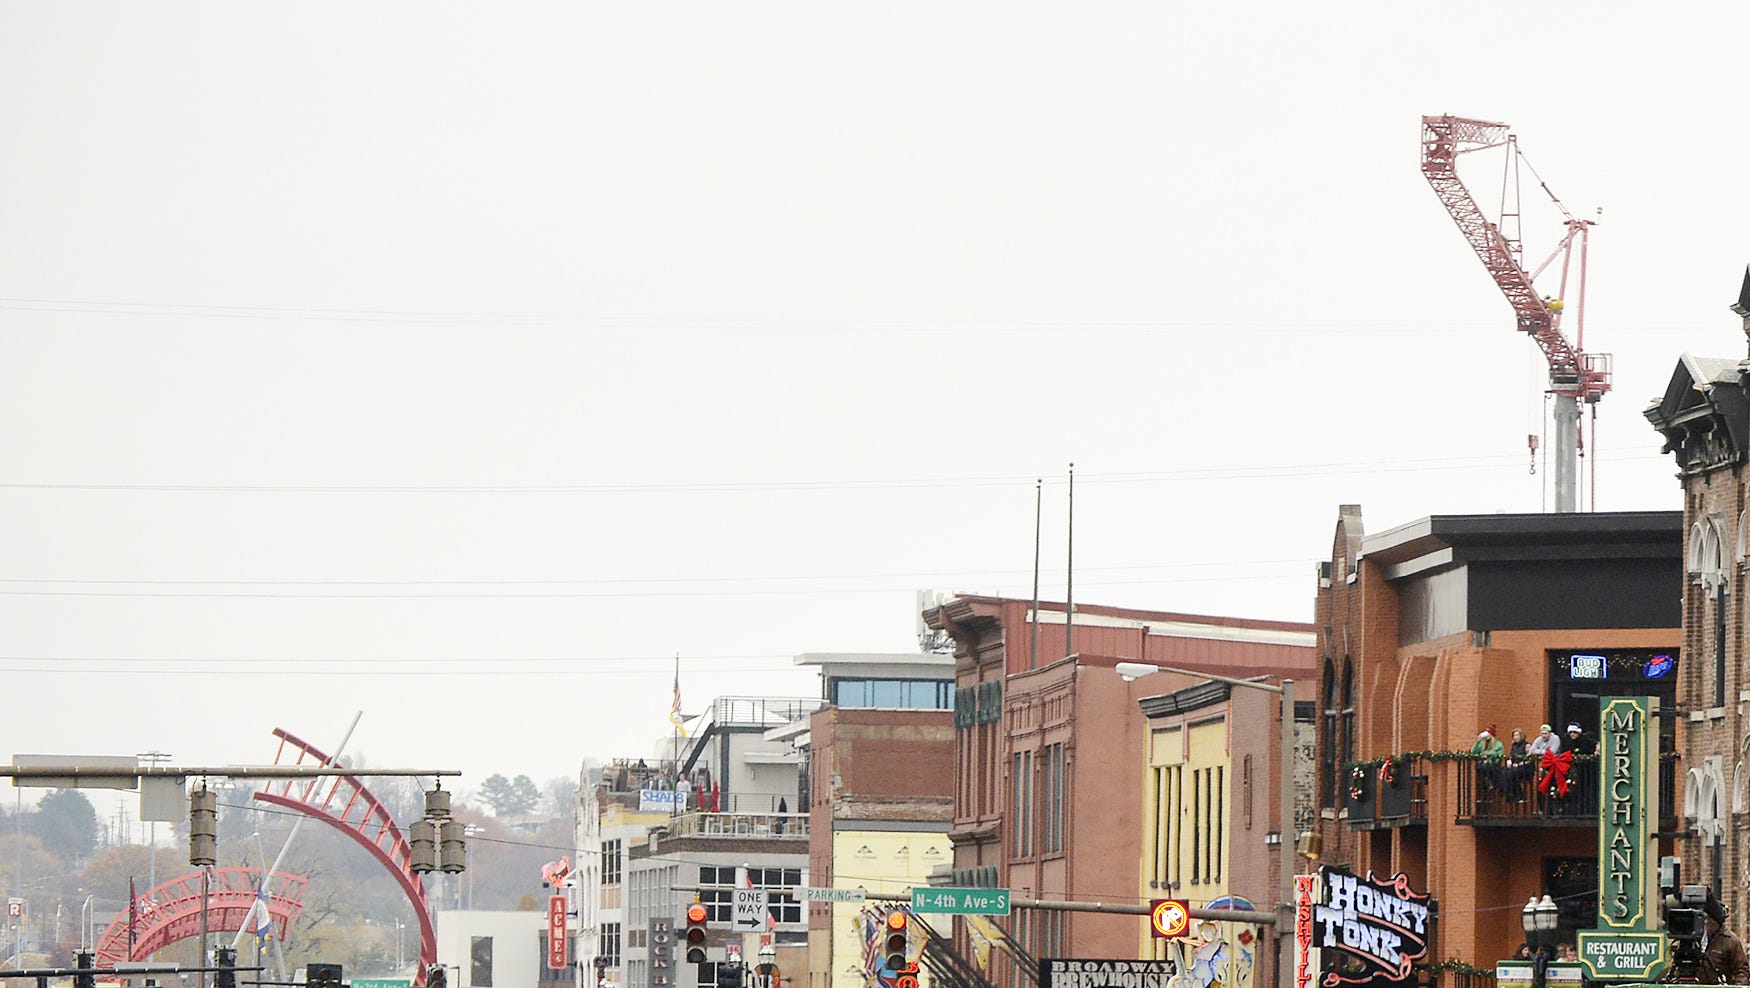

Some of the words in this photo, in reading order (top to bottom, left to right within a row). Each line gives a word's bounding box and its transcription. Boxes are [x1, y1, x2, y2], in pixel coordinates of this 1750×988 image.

[1577, 658, 1601, 668] BUD
[1609, 709, 1635, 919] MERCHANTS
[738, 892, 761, 902] ONE
[807, 890, 850, 901] PARKING
[916, 894, 956, 908] N-4th
[963, 894, 1005, 909] Ave-S
[738, 903, 763, 914] WAY
[1329, 872, 1427, 934] HONKY
[554, 901, 563, 954] ACME
[1316, 905, 1401, 965] TONK
[653, 922, 668, 968] ROCK
[1586, 942, 1657, 955] RESTAURANT
[1051, 961, 1175, 973] BROADWAY
[1596, 956, 1606, 969] &
[1615, 956, 1647, 969] GRILL
